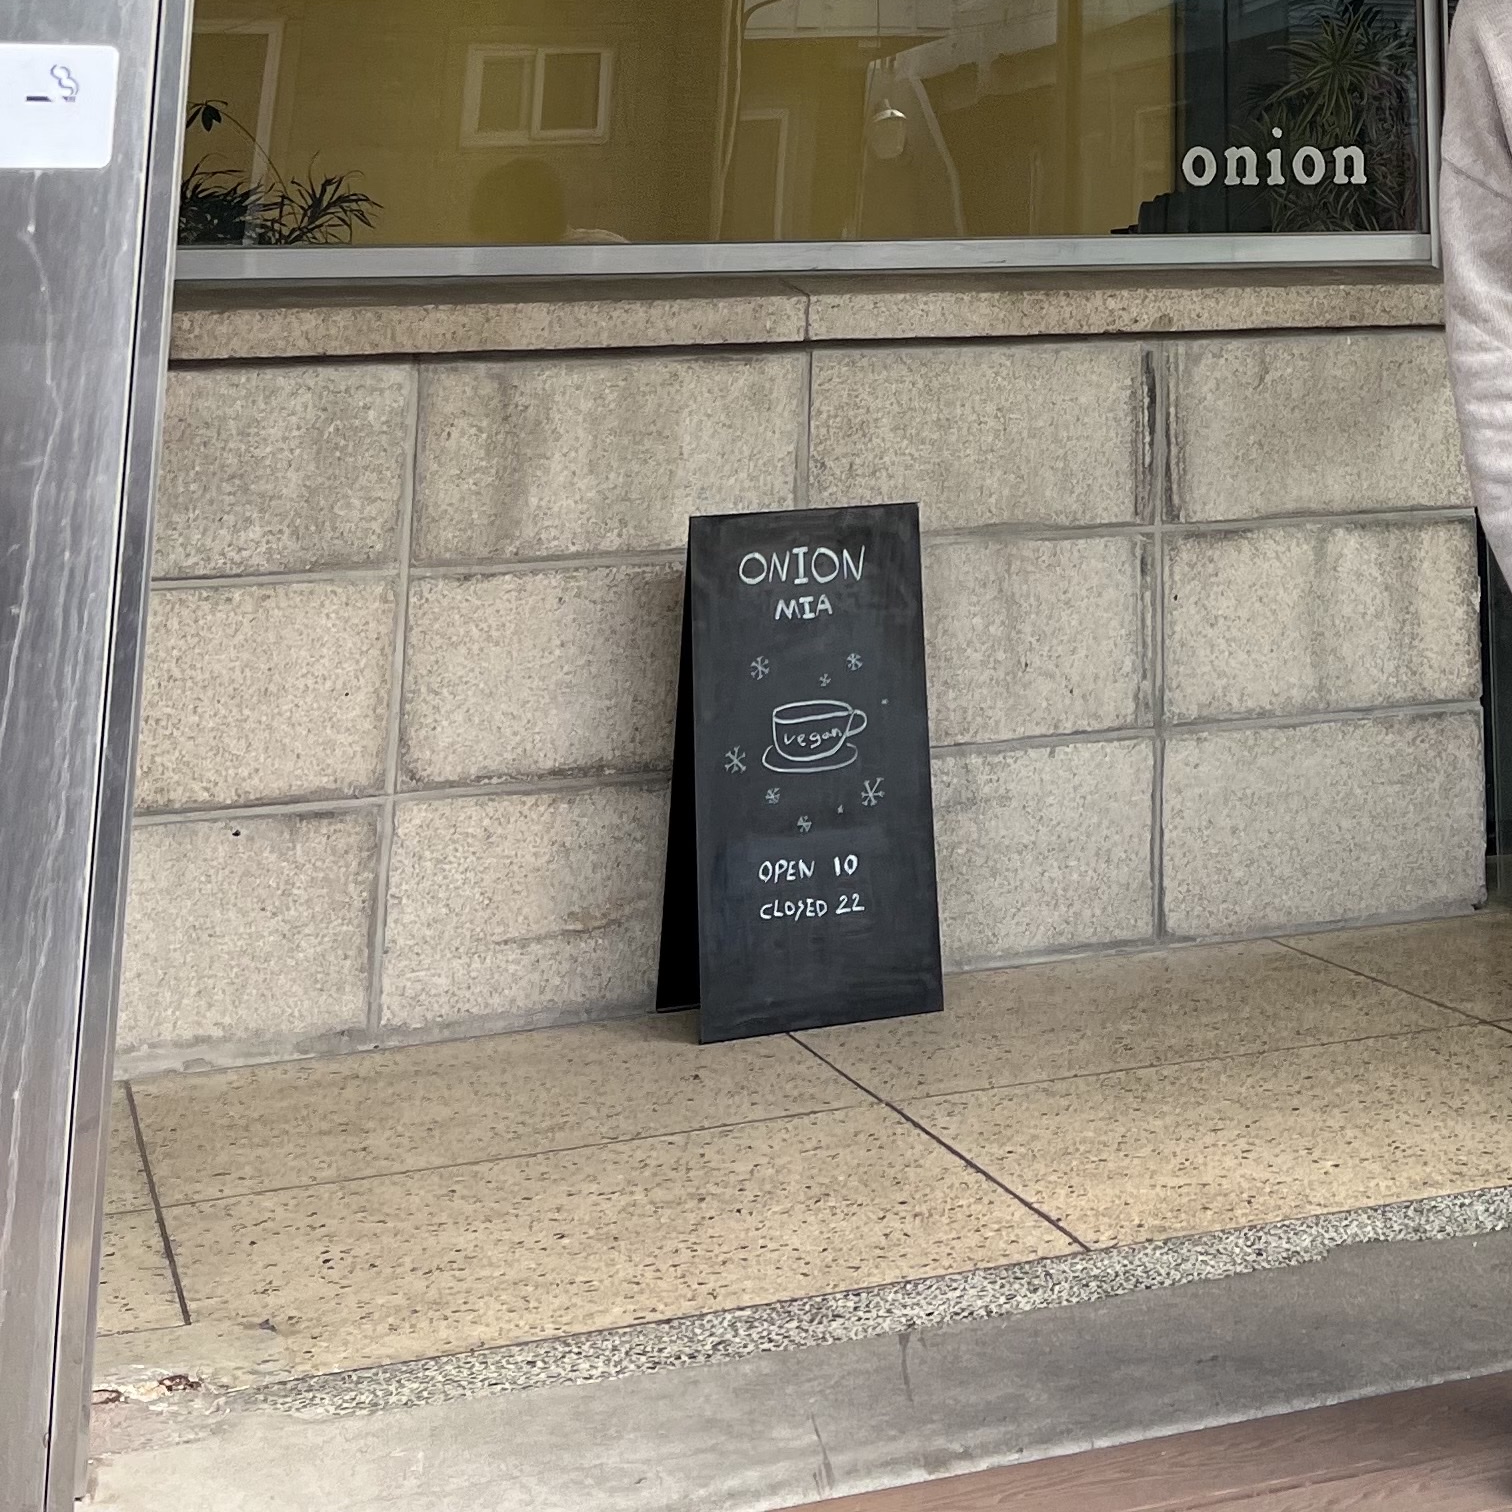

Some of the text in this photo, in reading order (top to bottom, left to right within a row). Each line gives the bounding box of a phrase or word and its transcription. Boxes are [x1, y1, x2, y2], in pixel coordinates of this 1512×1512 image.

[1182, 126, 1367, 186] onion
[738, 544, 866, 585] ONION
[774, 593, 833, 620] MIA
[783, 727, 843, 749] vegan
[758, 854, 859, 884] OPEN 10
[760, 892, 866, 922] CLOSED 22
